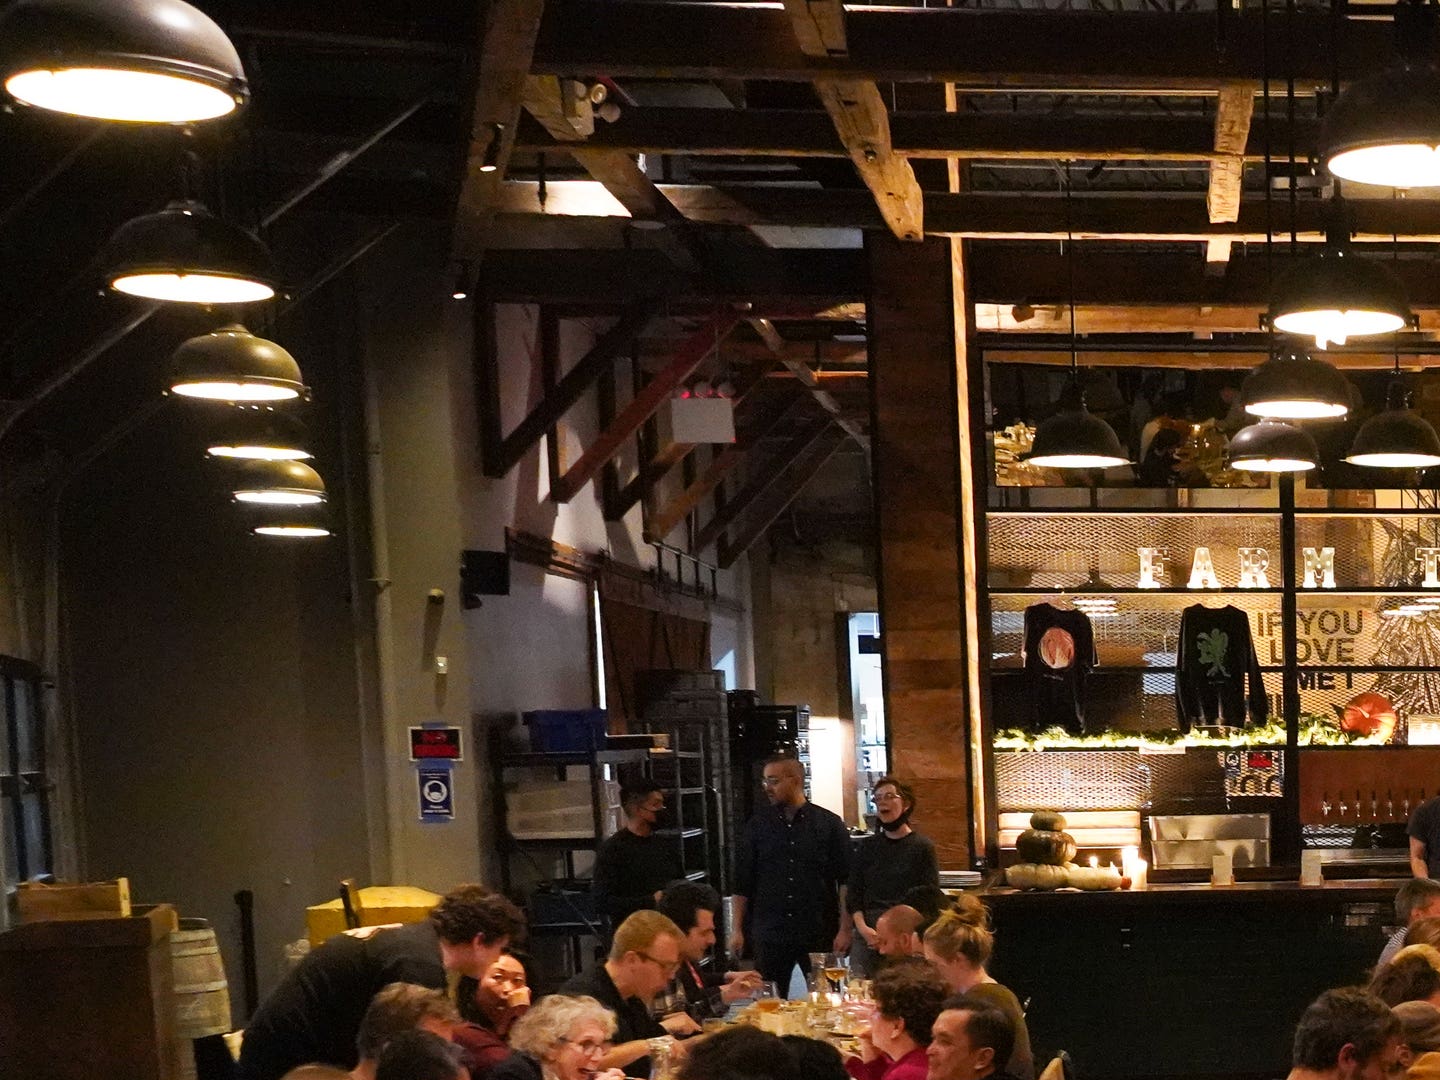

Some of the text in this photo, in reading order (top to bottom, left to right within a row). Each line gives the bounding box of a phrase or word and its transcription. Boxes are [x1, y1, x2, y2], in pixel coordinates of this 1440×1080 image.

[1137, 547, 1337, 588] FARM
[1257, 610, 1363, 636] IF YOU
[1269, 638, 1355, 663] LOVE
